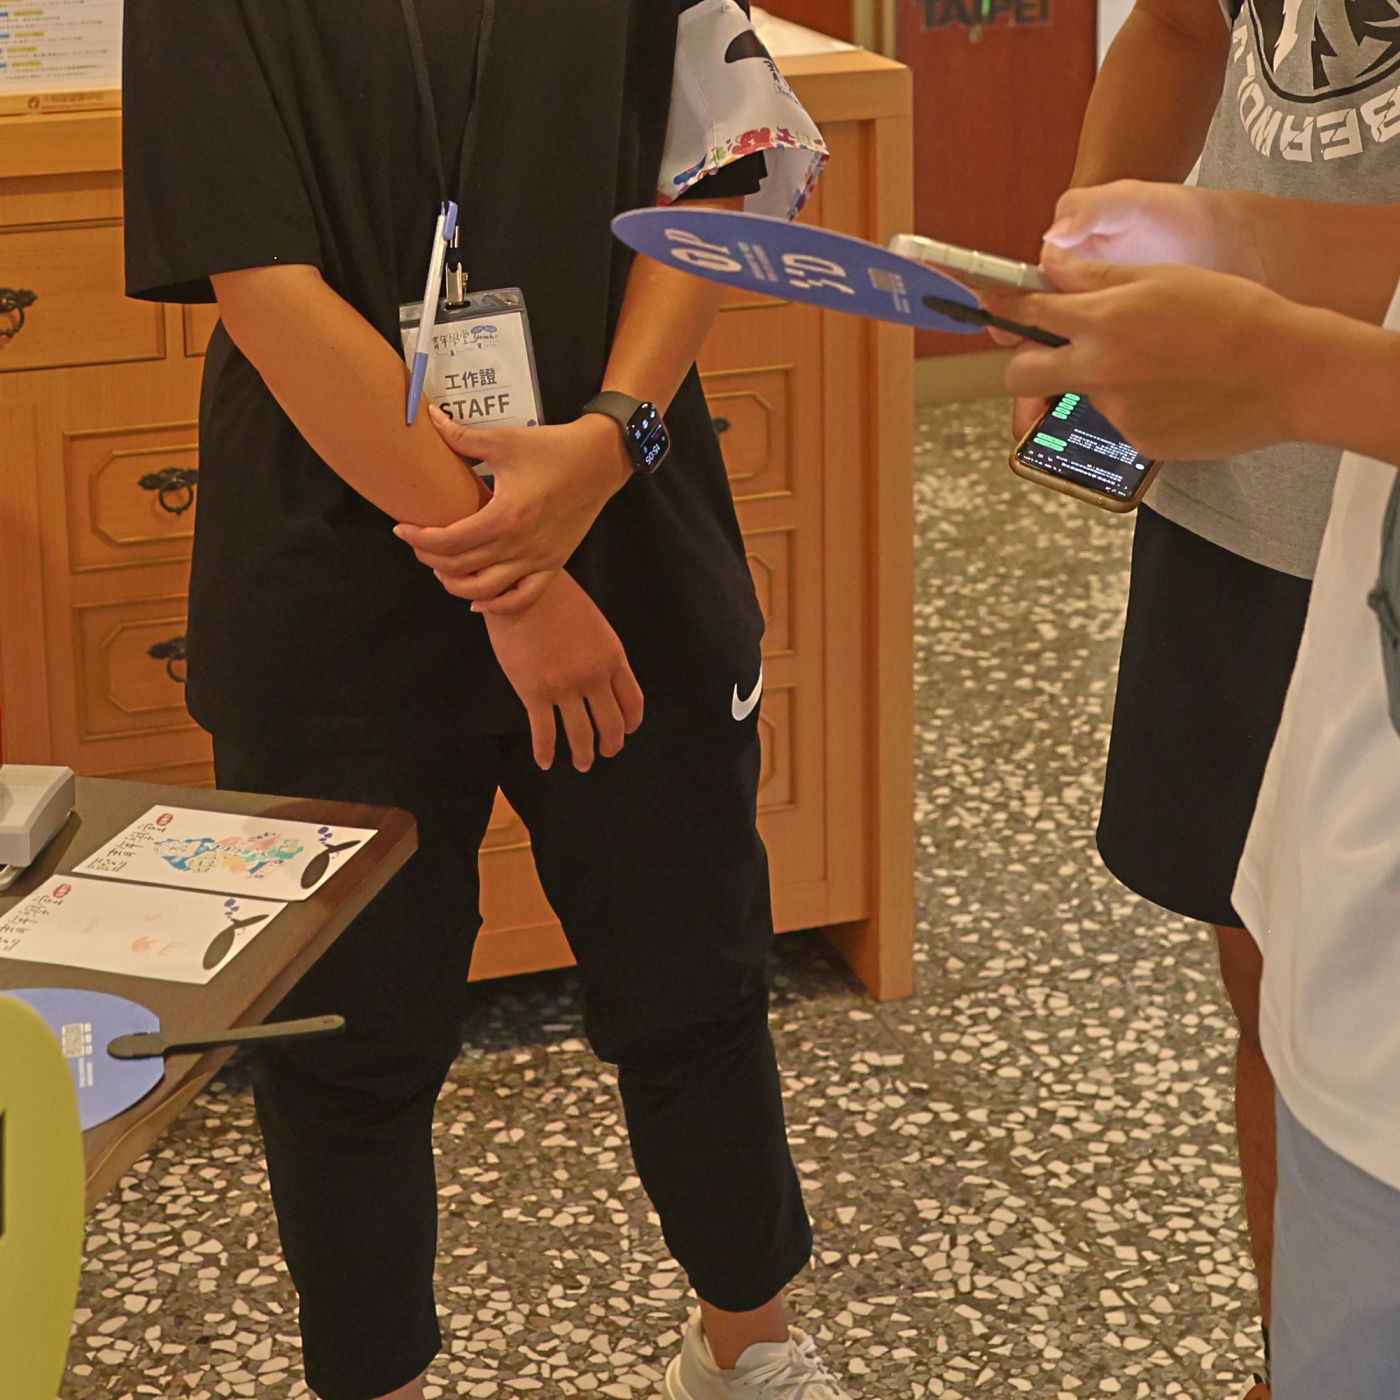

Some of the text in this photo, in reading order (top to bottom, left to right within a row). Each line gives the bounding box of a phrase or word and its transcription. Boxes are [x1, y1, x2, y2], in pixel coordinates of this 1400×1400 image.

[443, 367, 498, 391] 工作證
[441, 393, 511, 422] STAFF
[644, 443, 662, 466] 15:05
